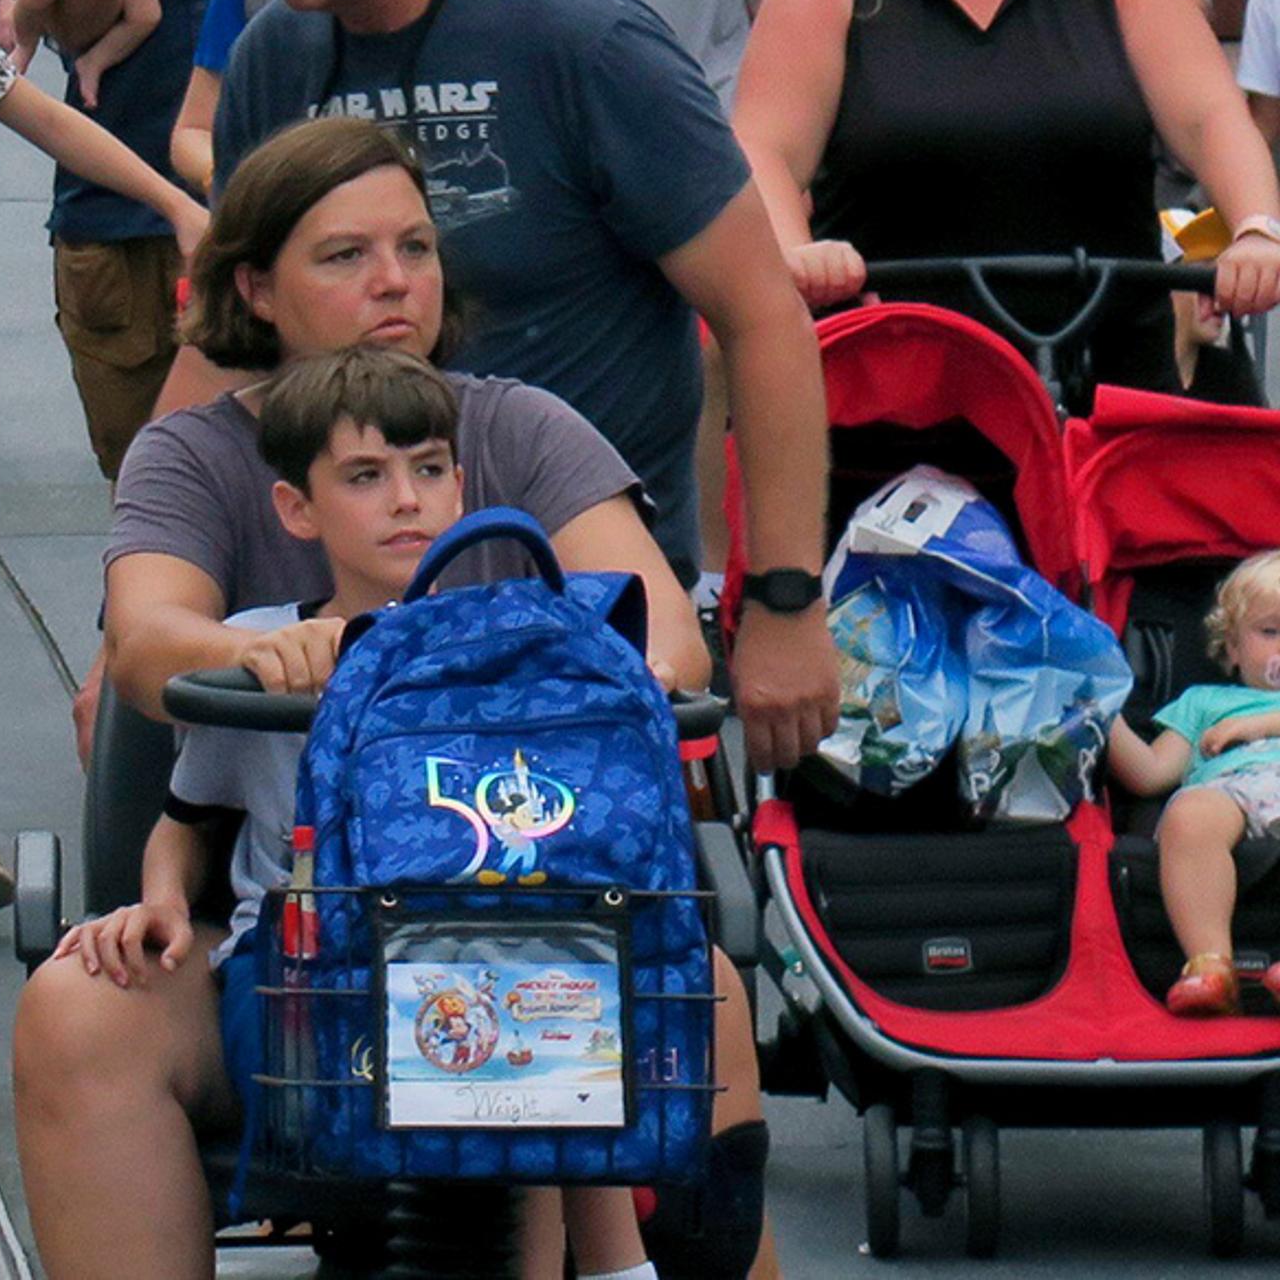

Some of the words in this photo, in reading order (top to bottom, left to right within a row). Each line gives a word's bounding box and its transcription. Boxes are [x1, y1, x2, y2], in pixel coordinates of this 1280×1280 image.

[380, 81, 498, 117] WARS
[417, 122, 490, 143] EDGE
[425, 755, 575, 885] 50
